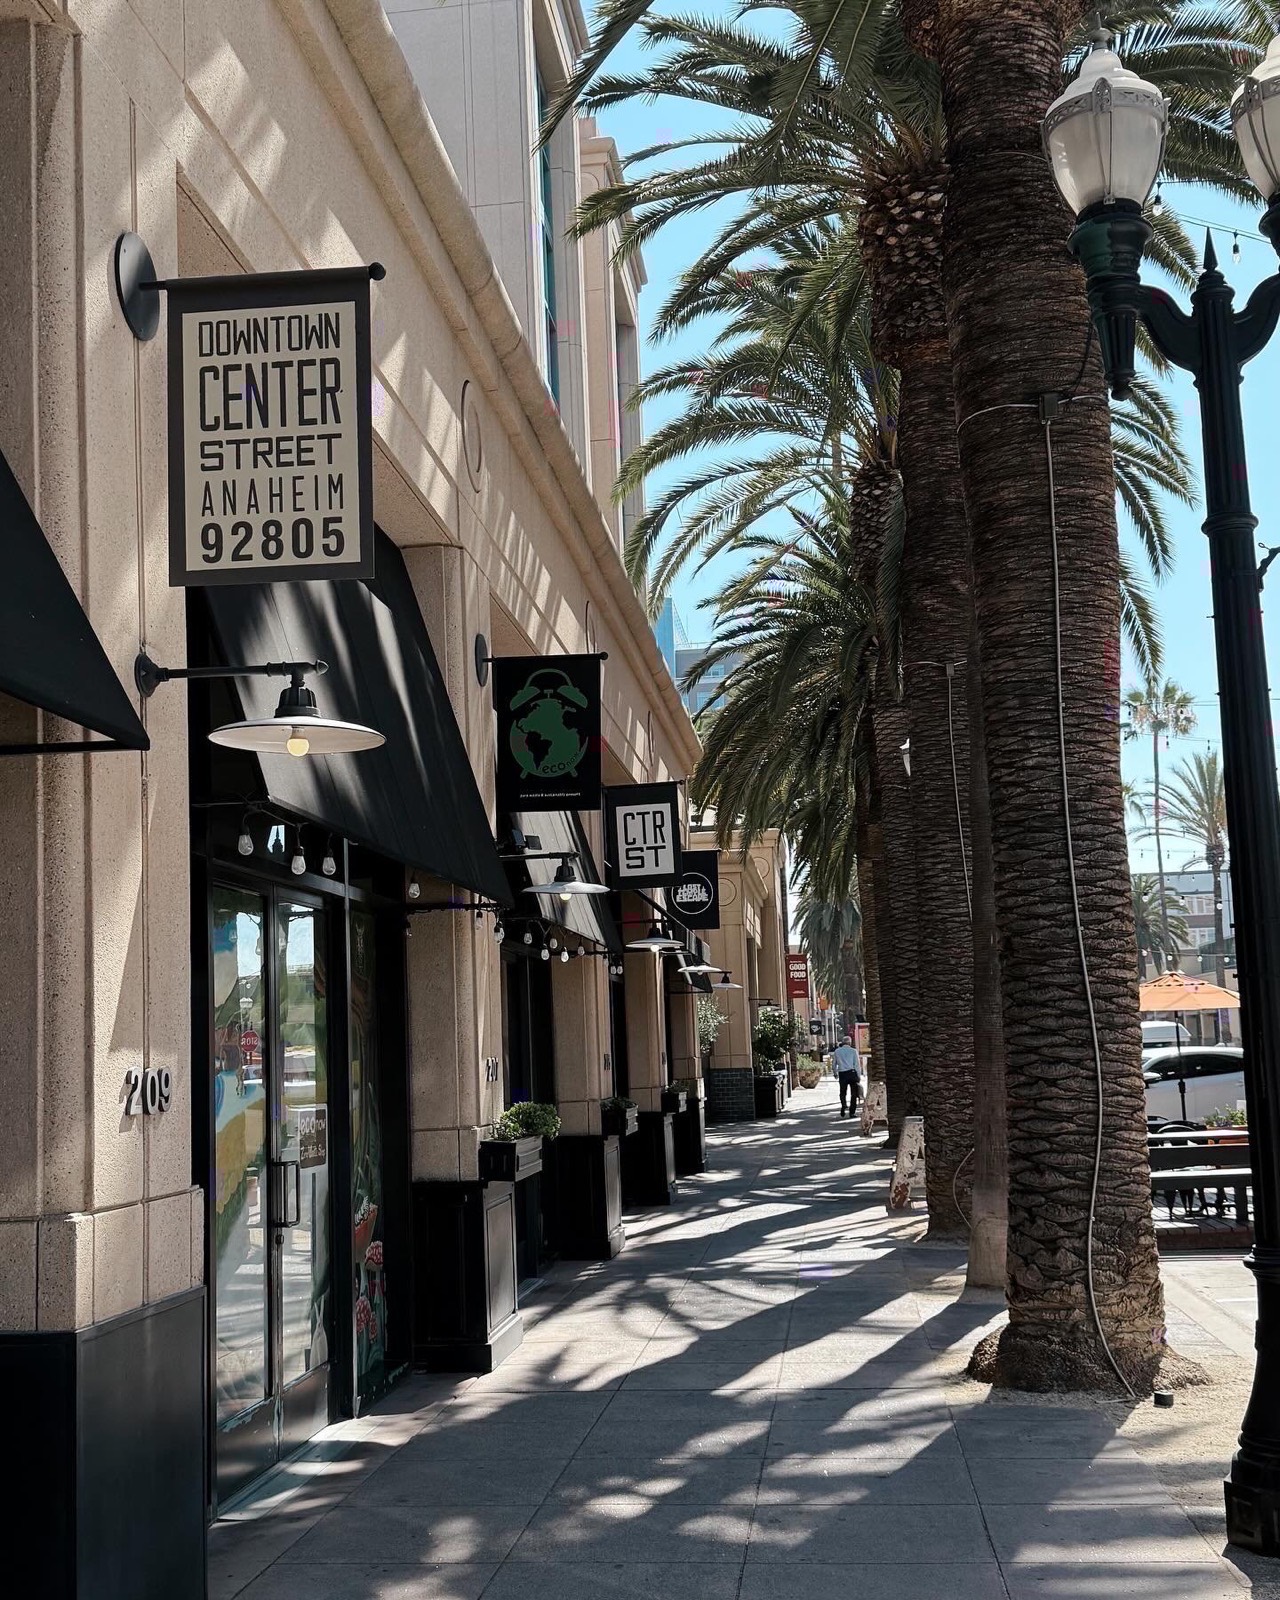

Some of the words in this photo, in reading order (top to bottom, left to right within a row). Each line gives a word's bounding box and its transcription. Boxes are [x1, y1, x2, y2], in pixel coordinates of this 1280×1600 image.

[198, 312, 340, 357] DOWNTOWN
[199, 357, 342, 432] CENTER
[200, 433, 342, 472] STREET
[201, 473, 344, 517] ANAHEIM
[201, 516, 345, 564] 92805
[623, 810, 665, 846] CTR
[625, 845, 666, 870] ST
[125, 1066, 171, 1116] 209
